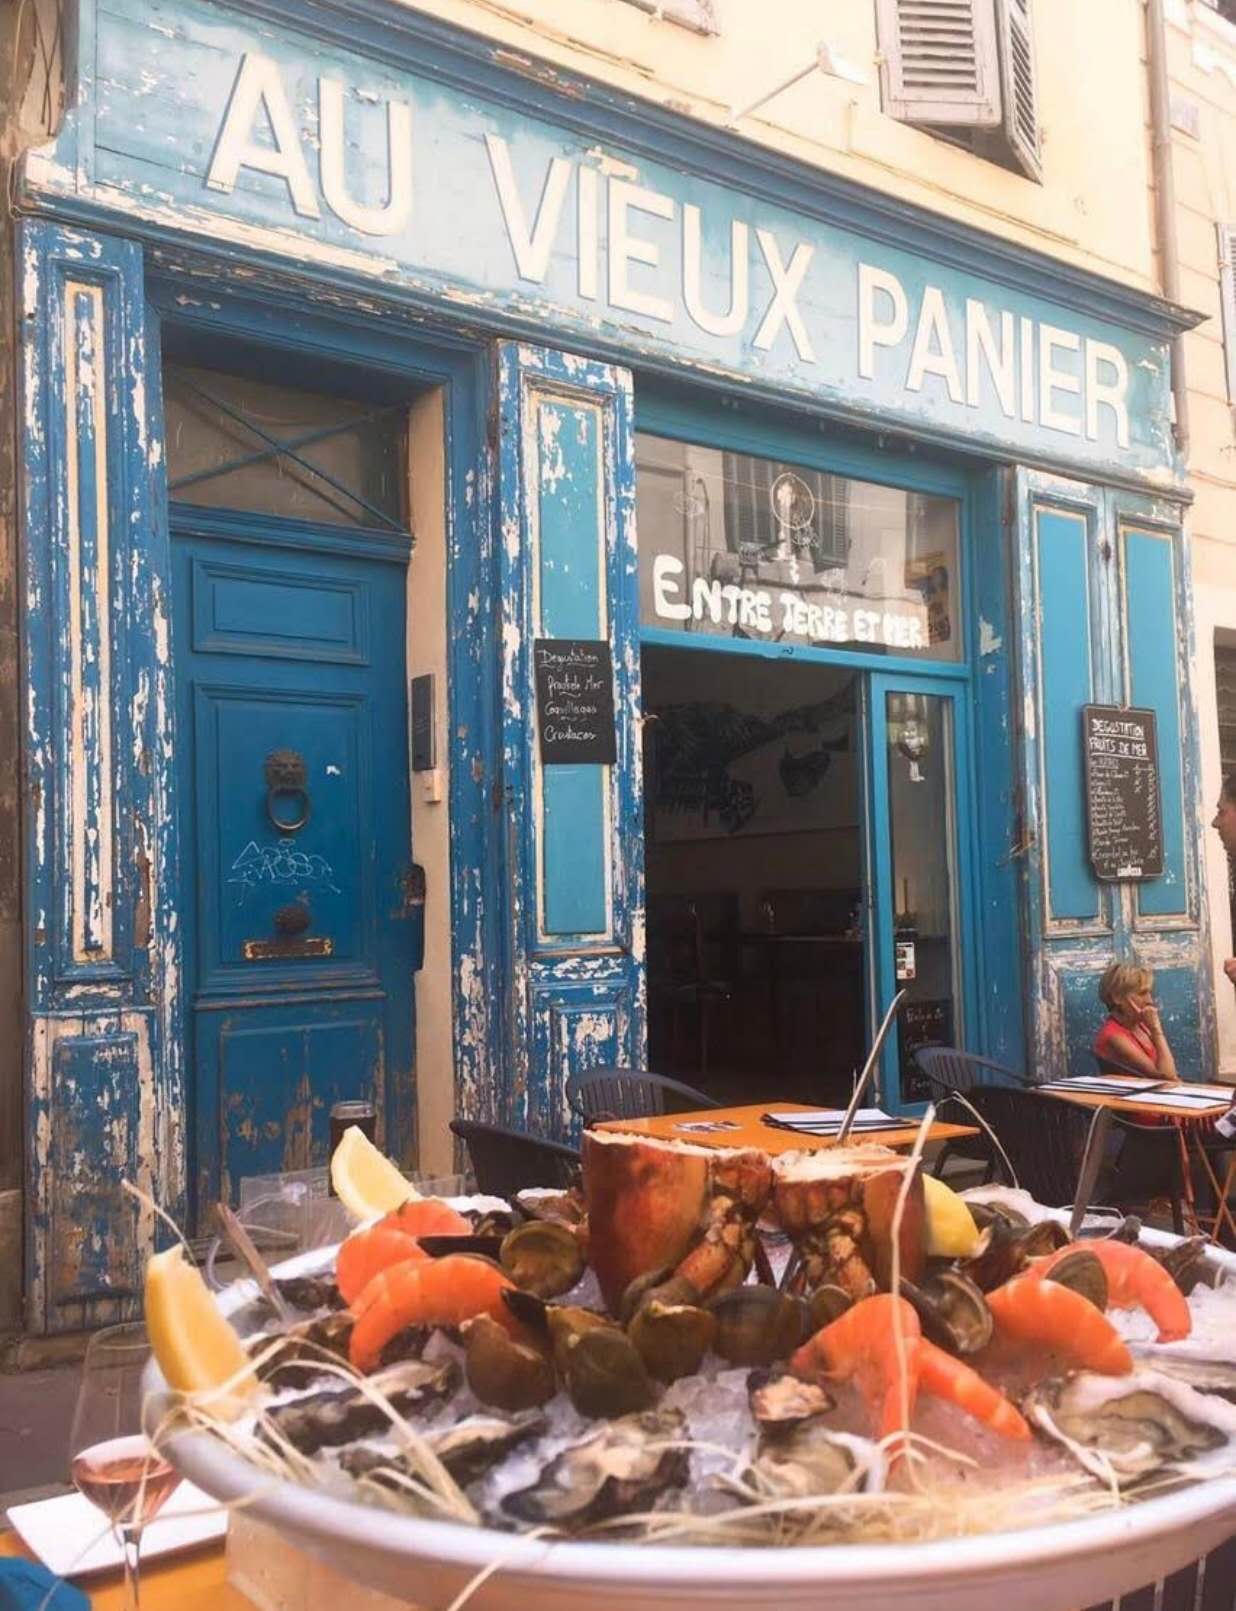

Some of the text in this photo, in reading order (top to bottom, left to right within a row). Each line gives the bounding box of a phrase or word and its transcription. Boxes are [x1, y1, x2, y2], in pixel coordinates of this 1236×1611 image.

[204, 51, 1131, 449] AU VIEUX PANIER
[652, 554, 924, 649] ENTRE TERRE ET MER
